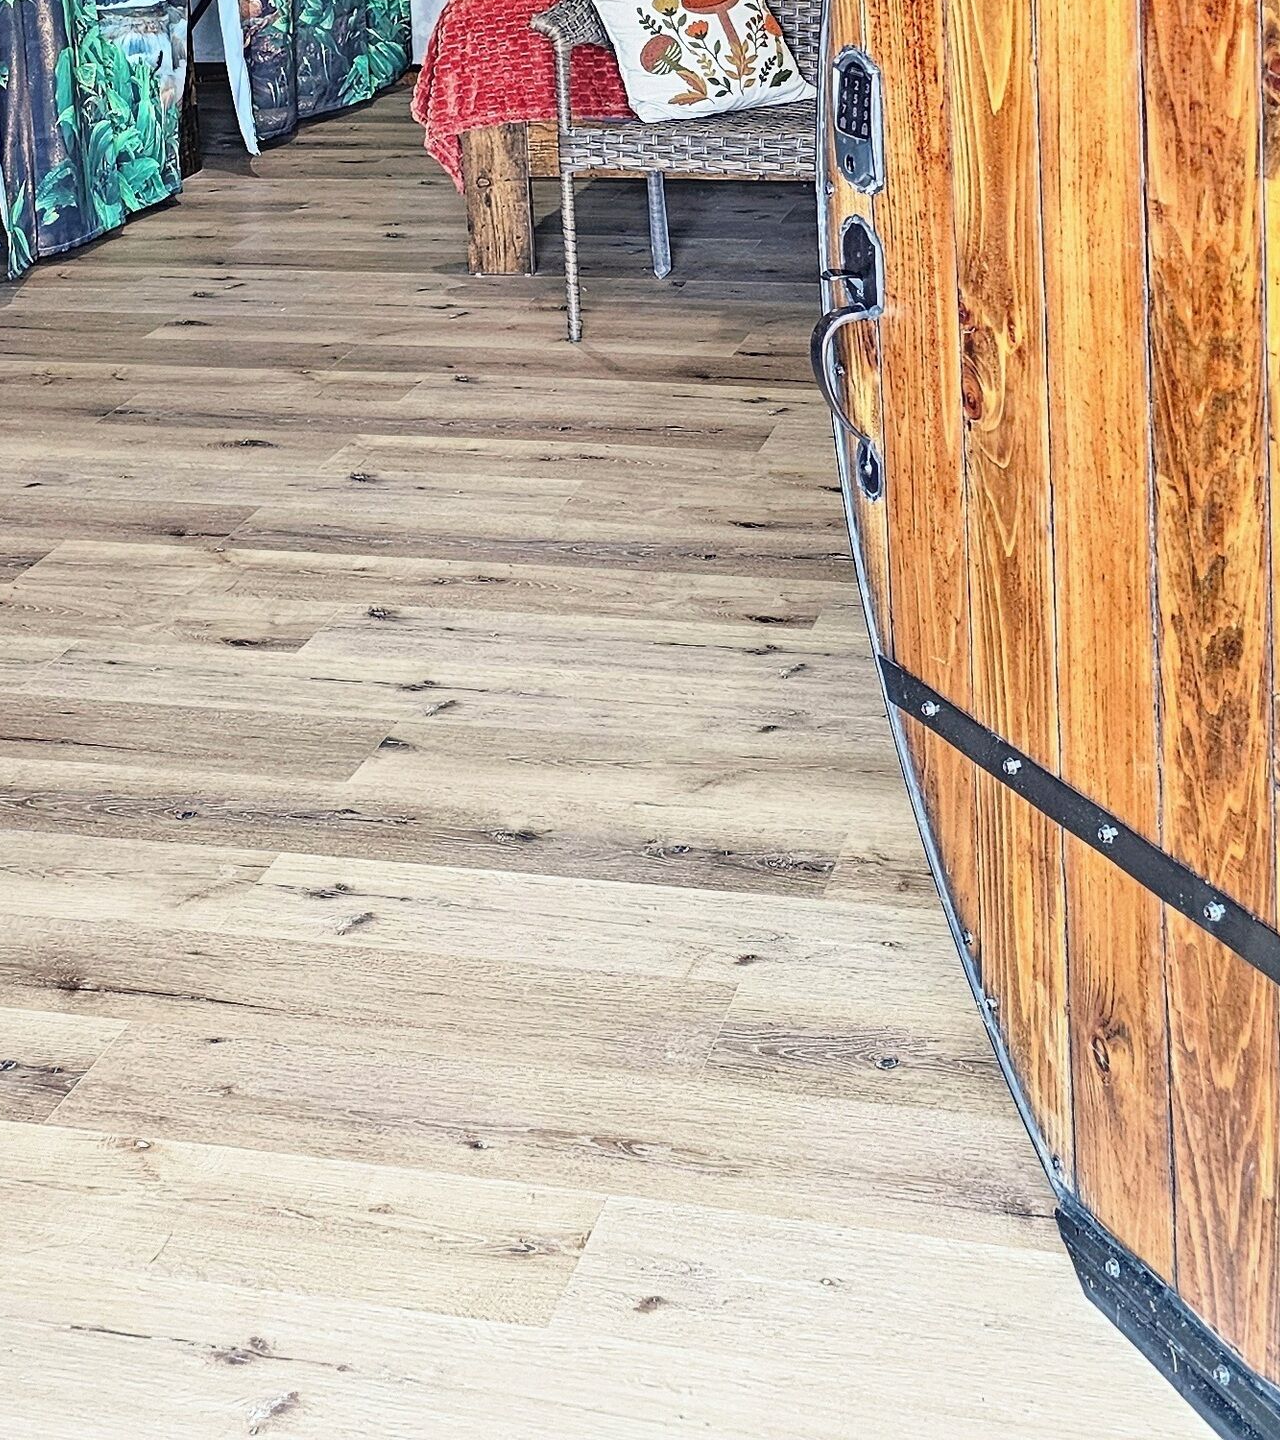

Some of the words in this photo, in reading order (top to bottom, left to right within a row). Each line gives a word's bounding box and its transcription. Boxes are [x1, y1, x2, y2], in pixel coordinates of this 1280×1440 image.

[853, 80, 860, 91] 2
[865, 83, 870, 94] 3
[842, 90, 848, 101] 4
[852, 93, 858, 105] 5
[863, 97, 869, 108] 6
[841, 103, 847, 114] 7
[852, 106, 858, 118] 8
[863, 110, 868, 121] 9
[851, 120, 857, 131] 0
